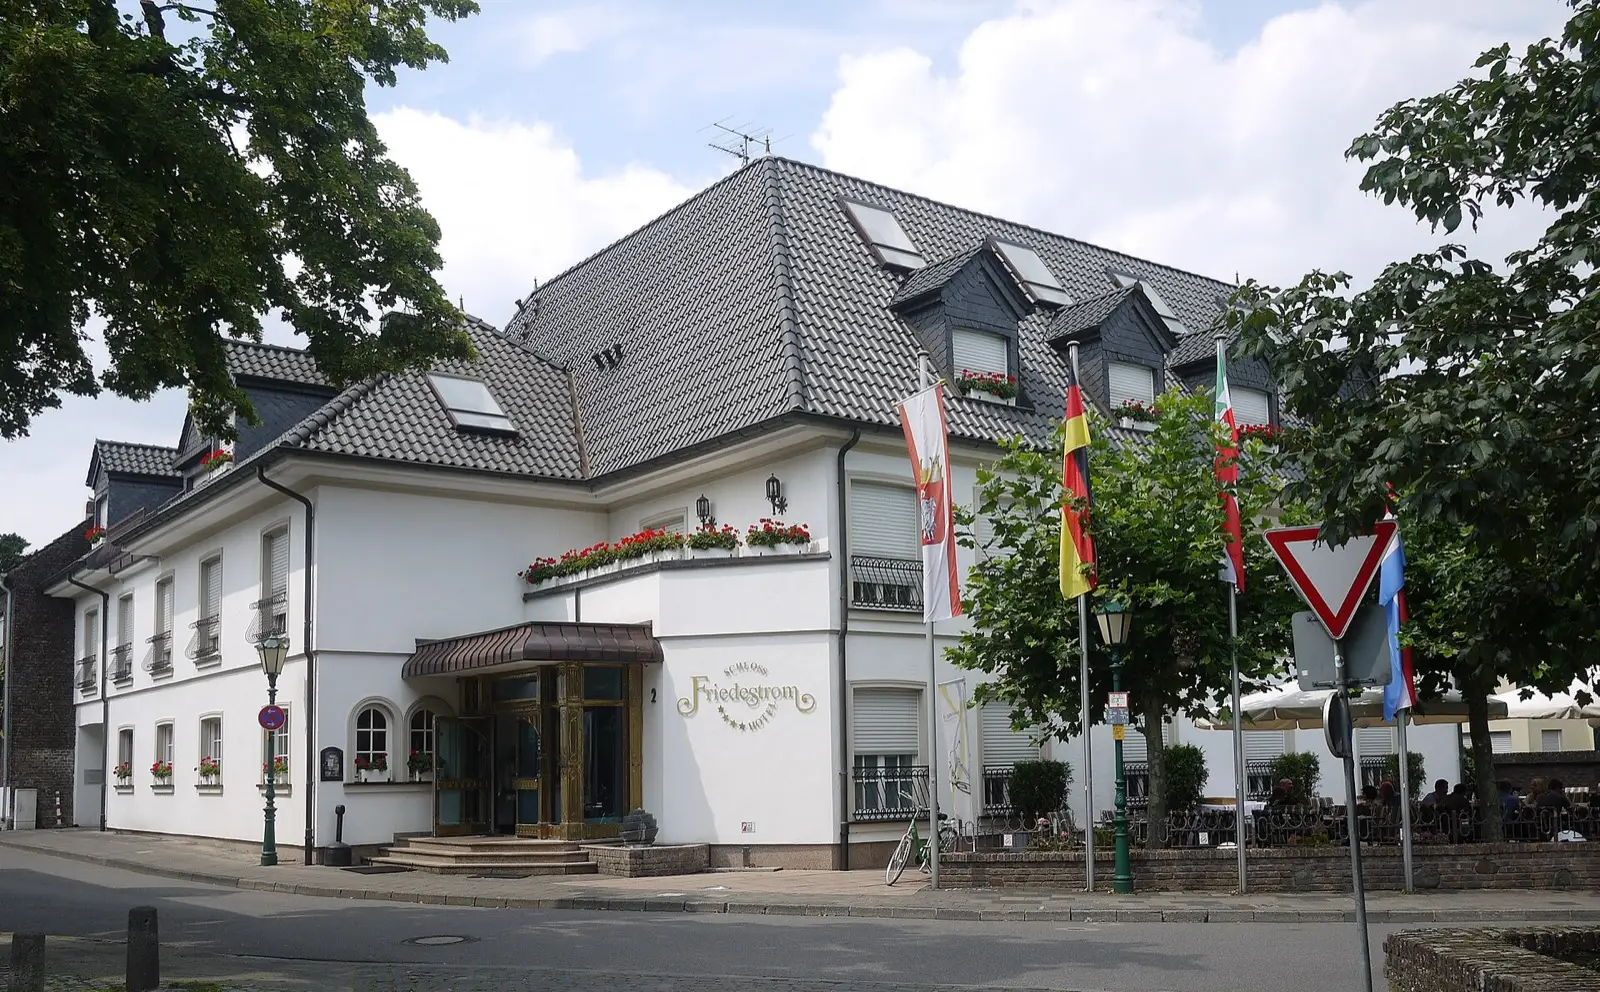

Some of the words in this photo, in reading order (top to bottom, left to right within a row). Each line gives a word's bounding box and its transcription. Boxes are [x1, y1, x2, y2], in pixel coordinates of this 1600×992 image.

[723, 661, 769, 677] SCHLOSS
[650, 687, 657, 703] 2
[677, 675, 816, 716] Friedestrom
[749, 702, 777, 732] HOTEL
